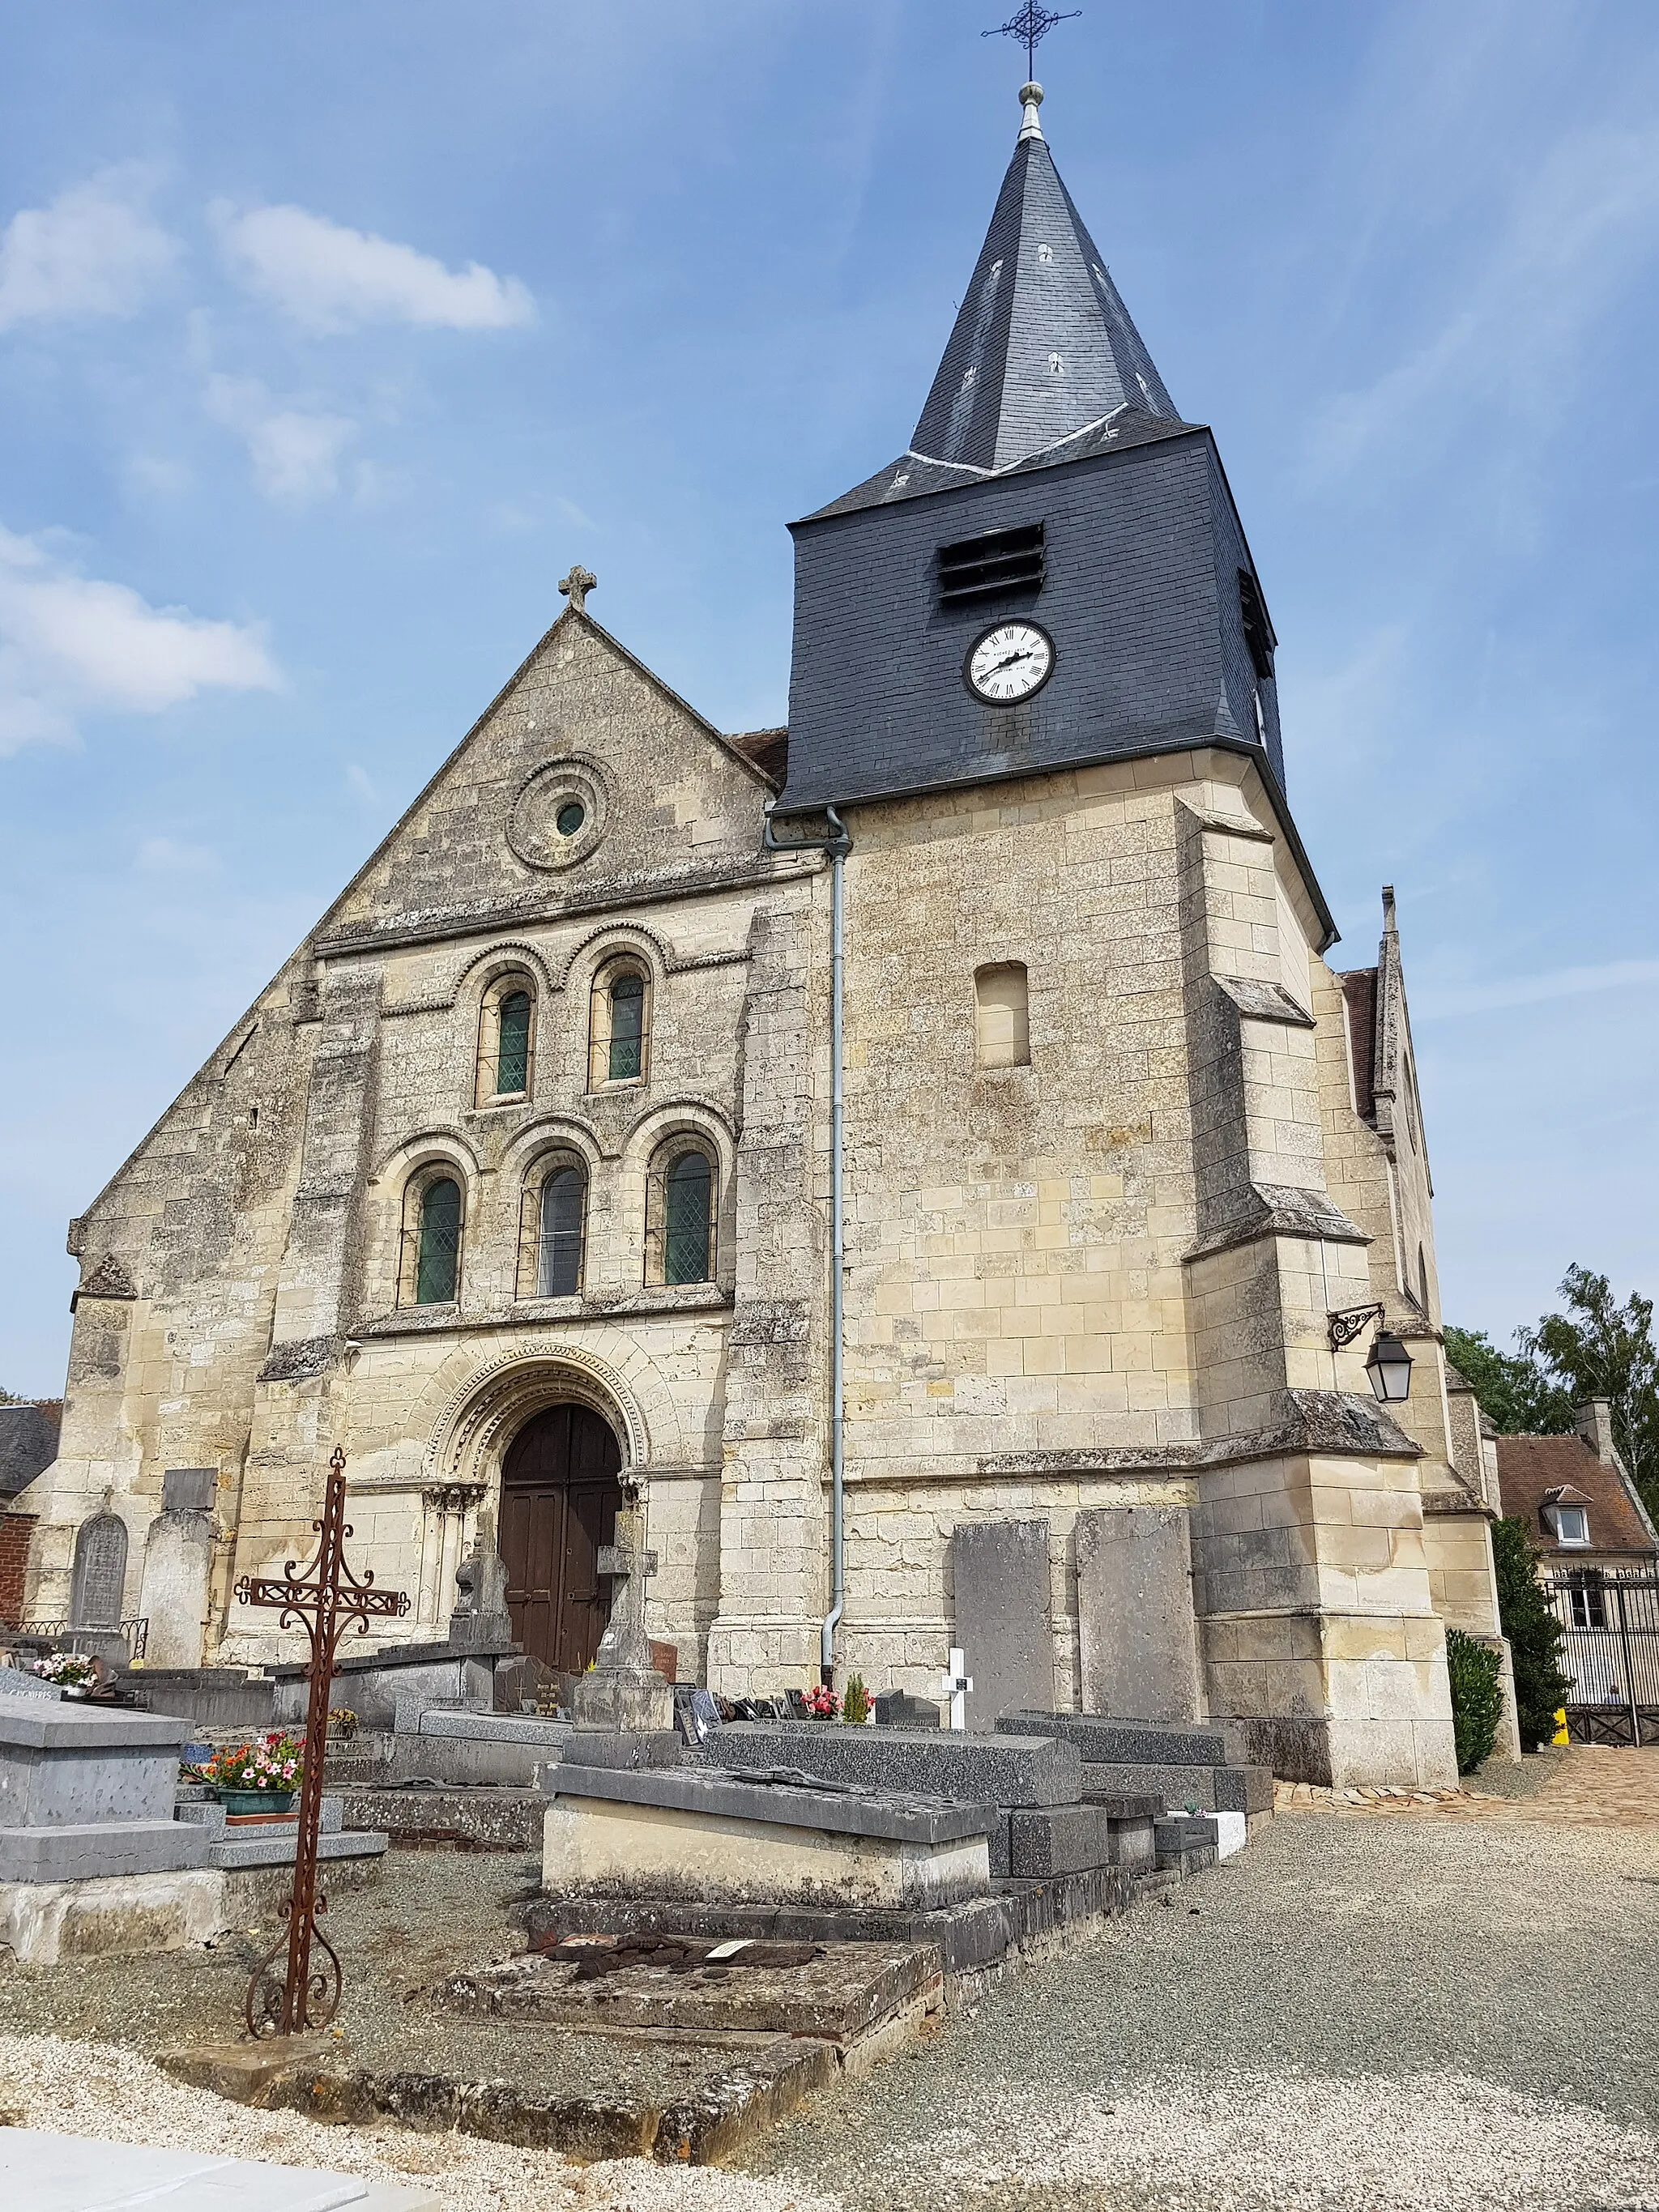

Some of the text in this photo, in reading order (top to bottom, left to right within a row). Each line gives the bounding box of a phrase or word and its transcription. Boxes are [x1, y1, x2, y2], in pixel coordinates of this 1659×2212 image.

[1004, 629, 1013, 641] XII
[1021, 631, 1027, 641] I
[989, 636, 1000, 647] XI
[1030, 639, 1041, 649] II
[978, 650, 990, 658] X
[975, 664, 986, 672] IX
[1029, 666, 1043, 676] IIII
[989, 683, 1000, 694] VII
[1022, 679, 1030, 688] V
[1006, 684, 1014, 695] VI
